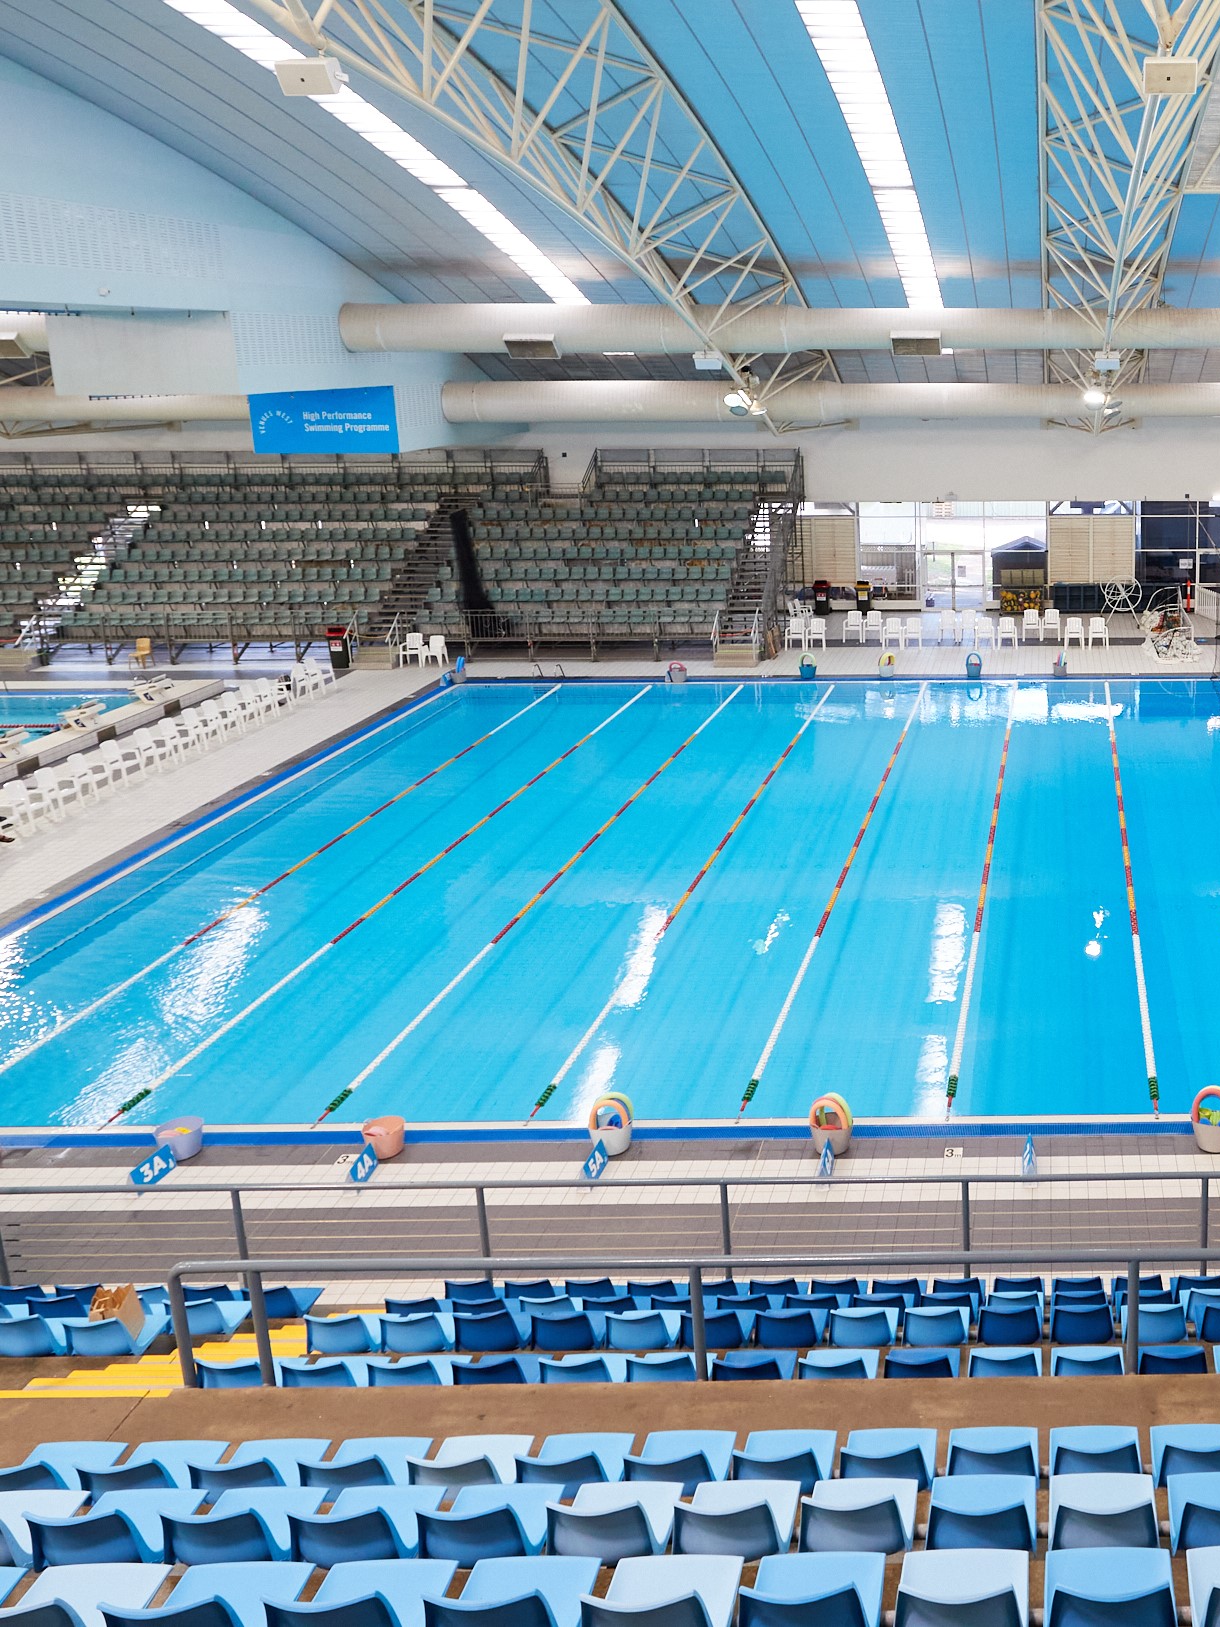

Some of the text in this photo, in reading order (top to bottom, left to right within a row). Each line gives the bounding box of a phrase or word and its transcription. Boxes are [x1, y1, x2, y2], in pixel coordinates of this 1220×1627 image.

[259, 410, 293, 434] VENUES WEST
[302, 411, 372, 422] High Performance
[304, 423, 390, 433] Swimming Programme
[140, 1155, 167, 1183] 3A
[357, 1153, 373, 1179] 4A
[588, 1150, 604, 1178] 5A
